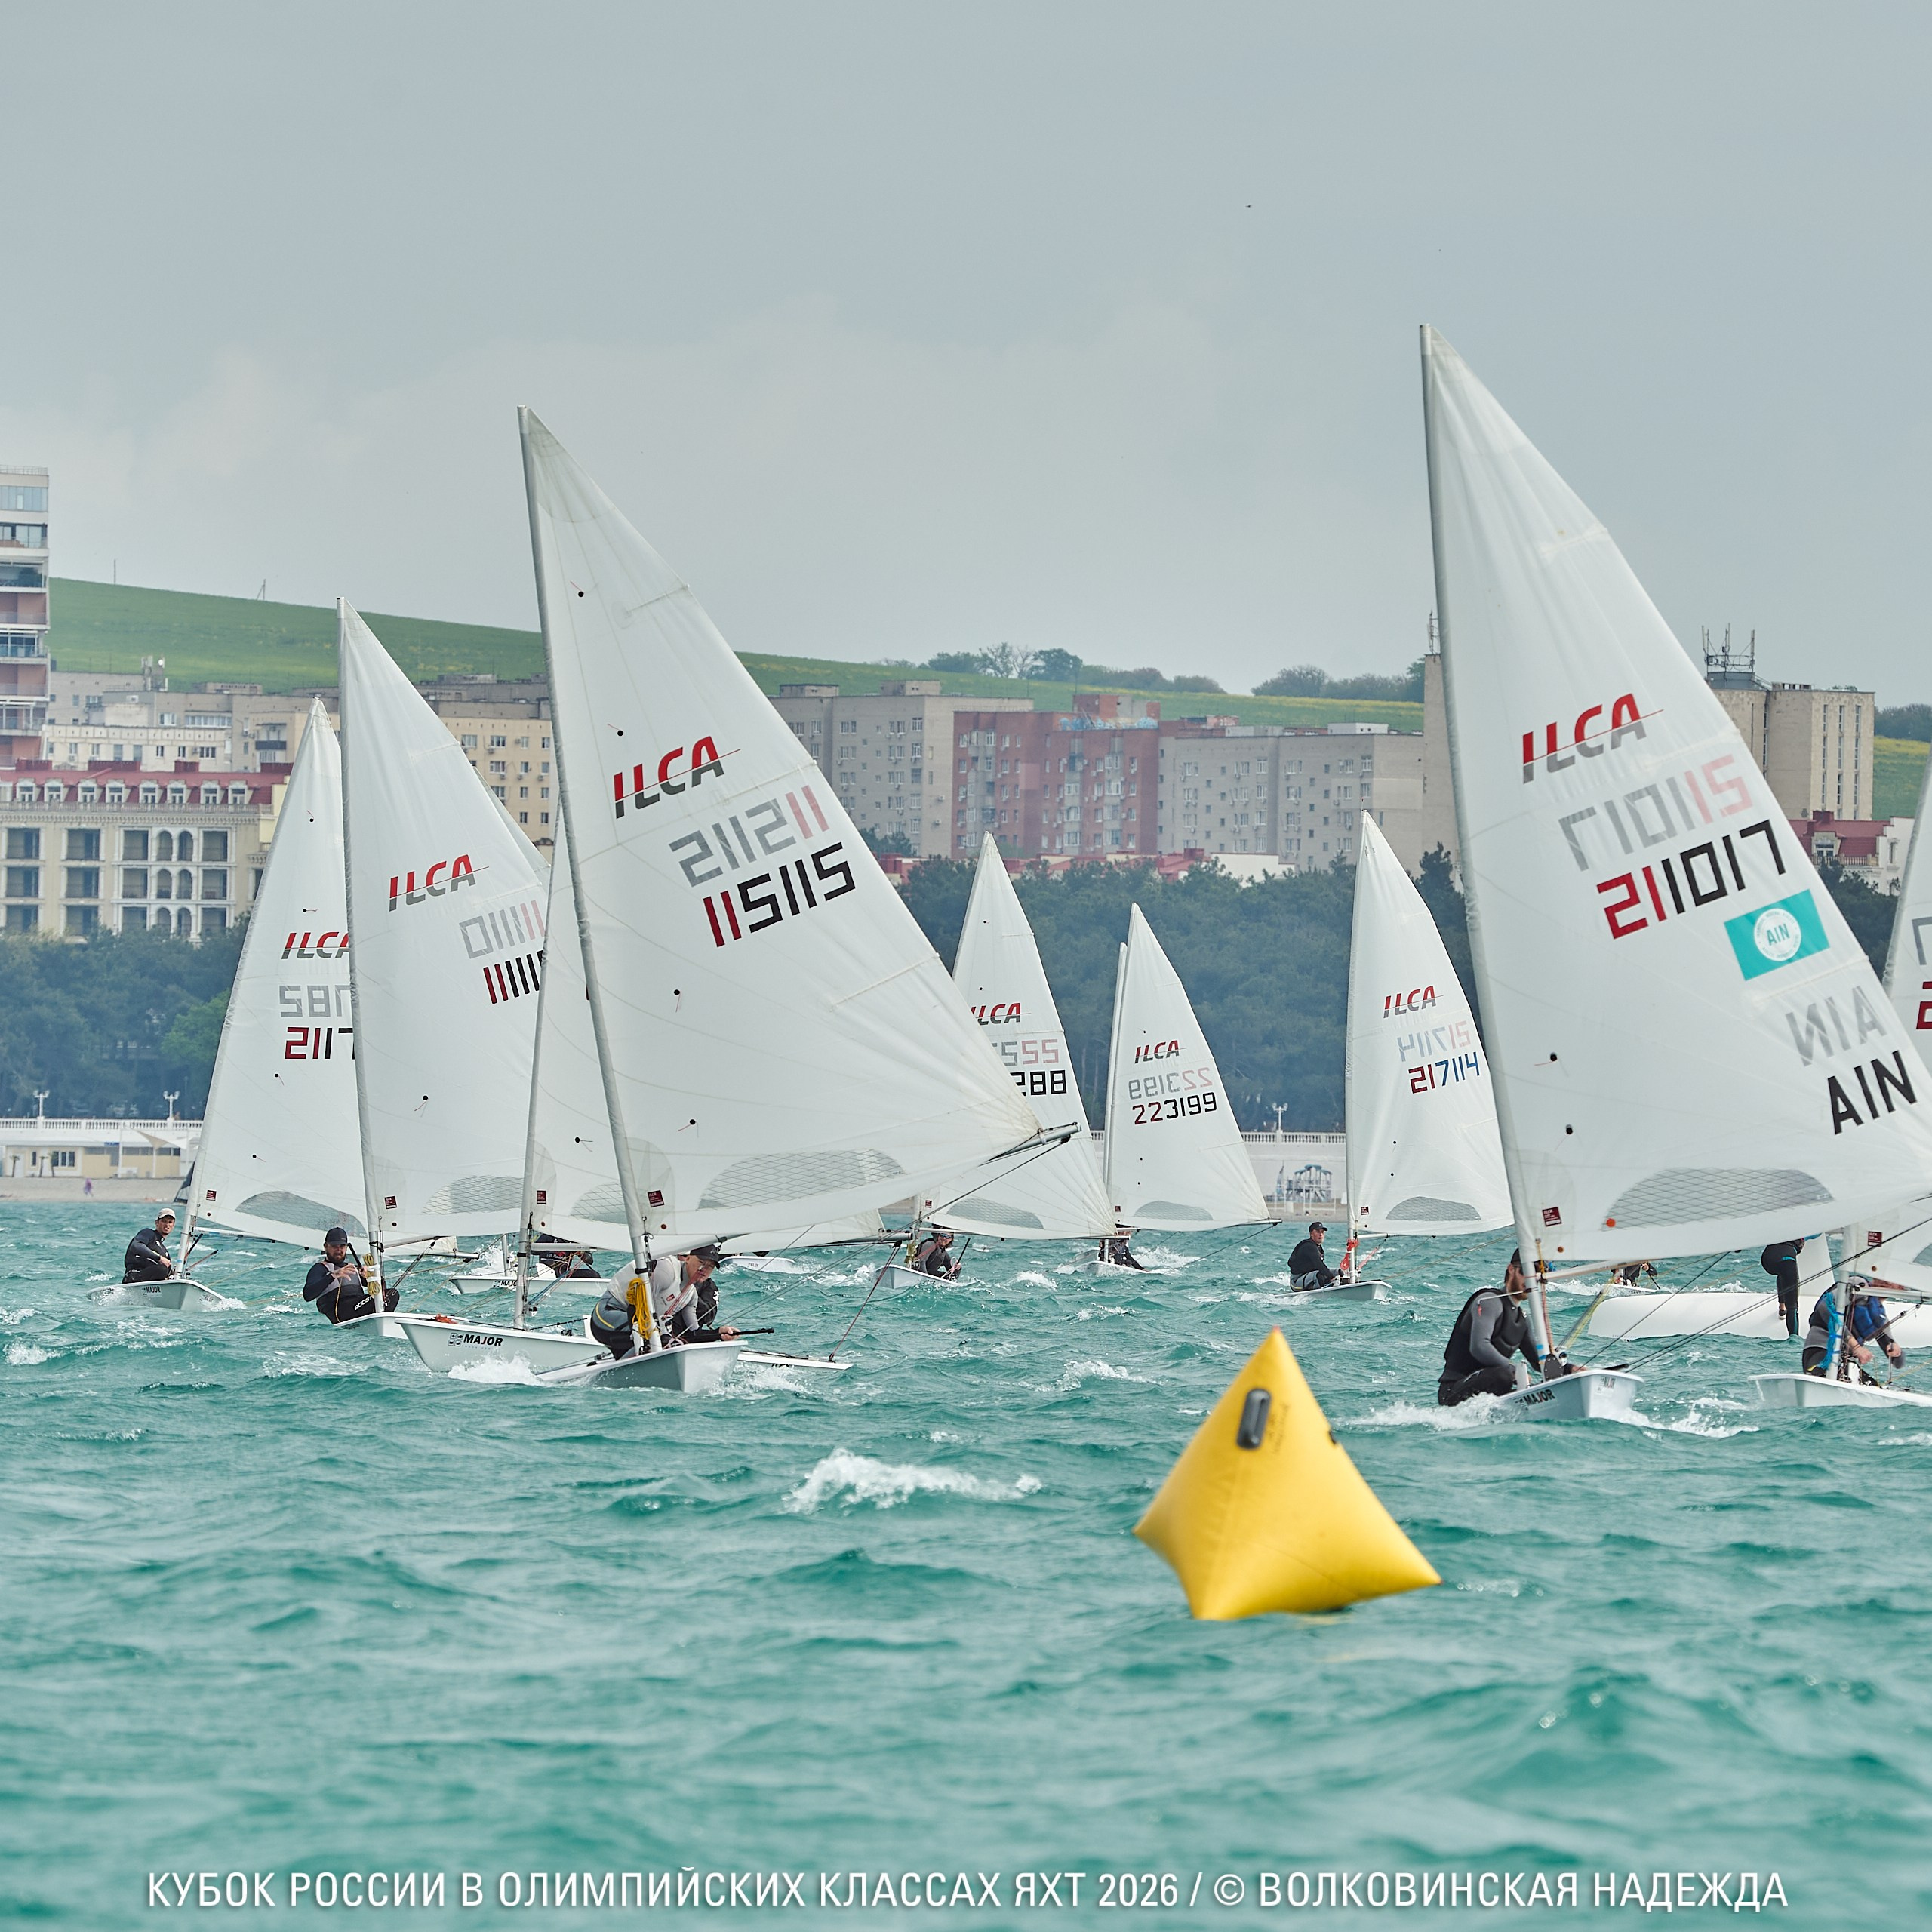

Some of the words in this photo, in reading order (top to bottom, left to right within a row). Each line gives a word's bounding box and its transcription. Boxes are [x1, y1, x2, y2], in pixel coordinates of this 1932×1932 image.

[1522, 693, 1647, 784] ILCA
[614, 736, 724, 819] ILCA
[389, 854, 476, 912] ILCA
[703, 841, 856, 948] 115115
[1596, 819, 1786, 940] 211017
[1766, 923, 1791, 946] AIN
[483, 950, 544, 1004] 11111
[1383, 986, 1437, 1018] ILCA
[1134, 1040, 1180, 1063] ILCA
[1408, 1051, 1480, 1094] 217114
[1132, 1092, 1217, 1125] 223199
[1828, 1050, 1918, 1136] AIN
[463, 1334, 503, 1346] MAJOR
[1524, 1389, 1555, 1406] MAJOR
